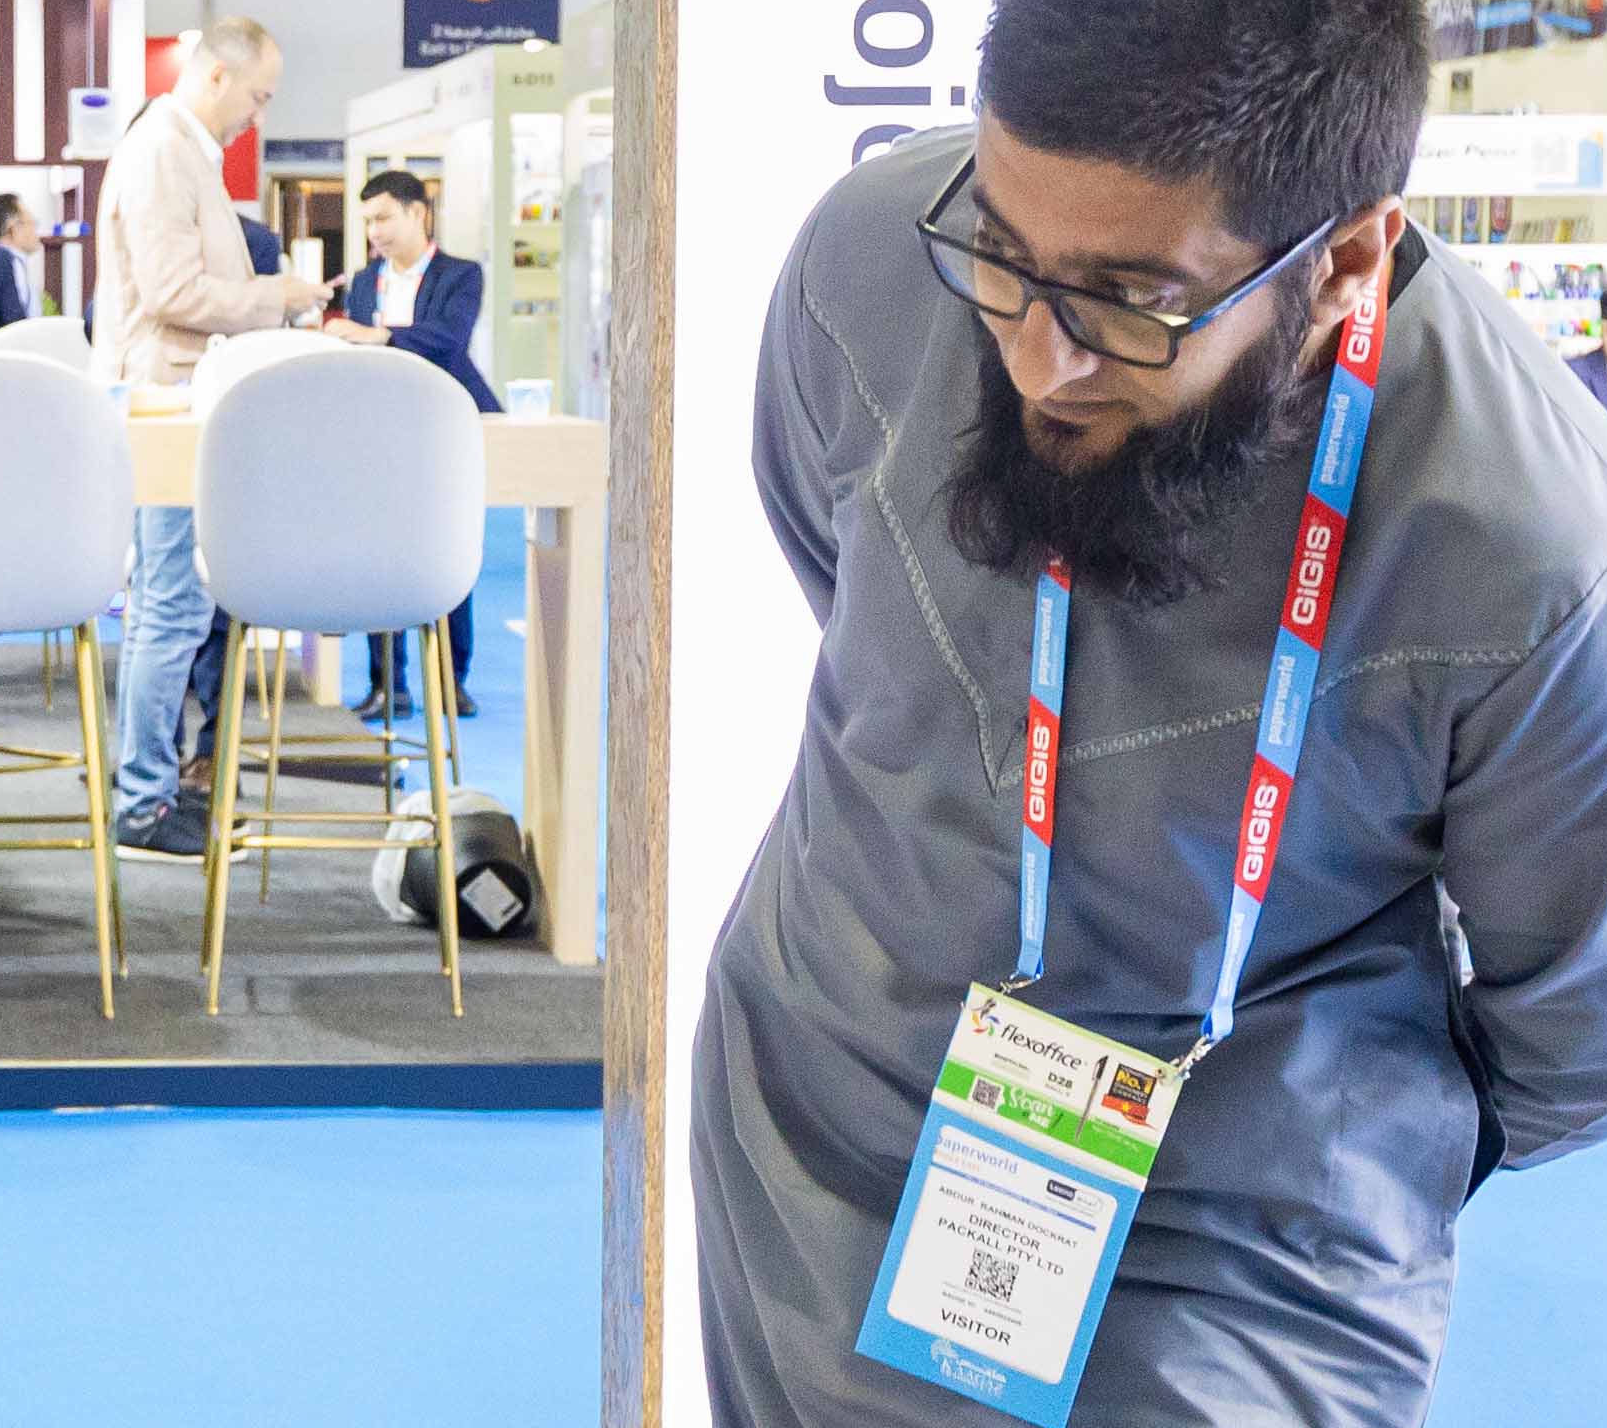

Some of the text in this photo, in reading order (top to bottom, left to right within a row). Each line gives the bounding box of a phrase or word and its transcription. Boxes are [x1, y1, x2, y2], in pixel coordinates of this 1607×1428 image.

[1268, 655, 1295, 745] paperworld
[1001, 1024, 1082, 1070] flexoffice
[939, 1217, 1064, 1276] PACKALL PTY LTD
[969, 1214, 1041, 1250] DIRECTOR
[941, 1308, 1012, 1346] VISITOR
